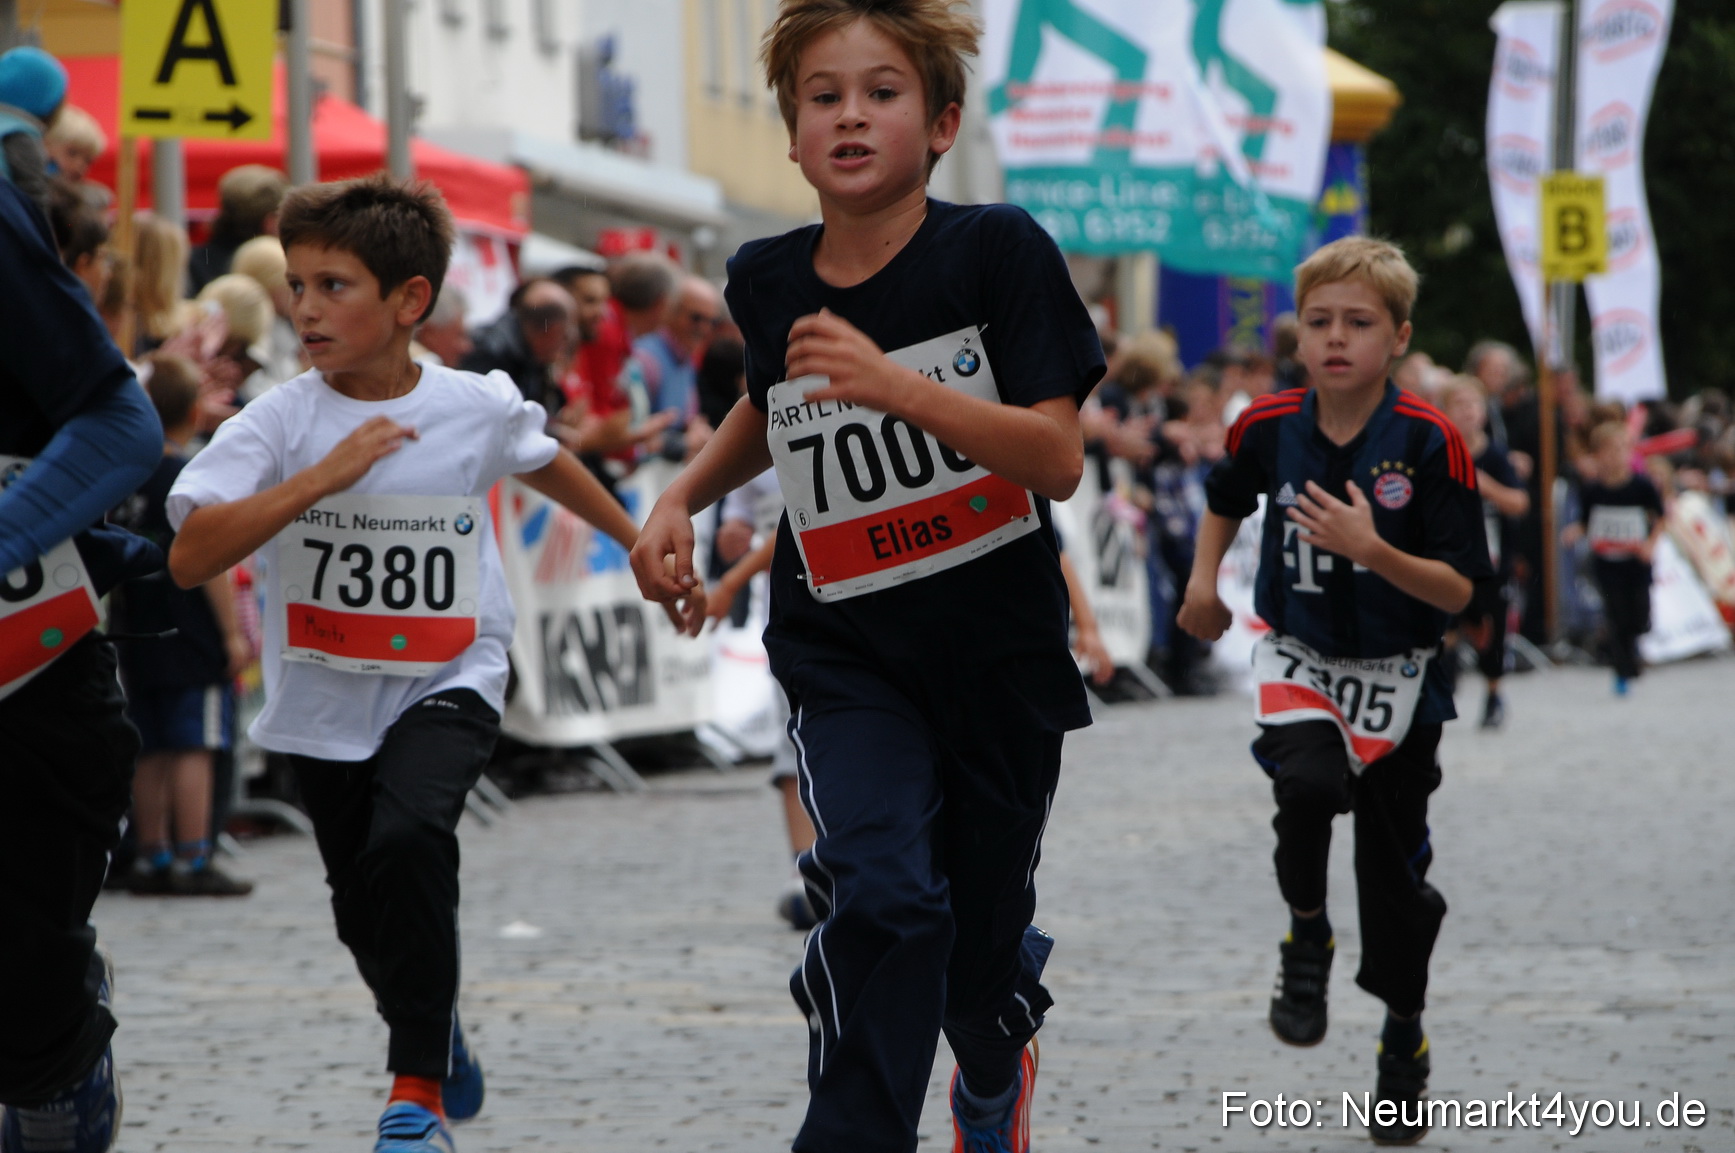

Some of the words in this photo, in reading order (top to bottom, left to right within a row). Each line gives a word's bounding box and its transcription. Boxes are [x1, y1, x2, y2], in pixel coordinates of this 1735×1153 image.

[156, 0, 237, 85] A
[1558, 206, 1591, 256] B
[771, 399, 833, 431] PARTL
[294, 509, 347, 530] ARTL
[353, 513, 447, 532] Neumarkt
[799, 512, 808, 527] 6
[866, 513, 953, 561] Elias
[303, 538, 456, 611] 7380
